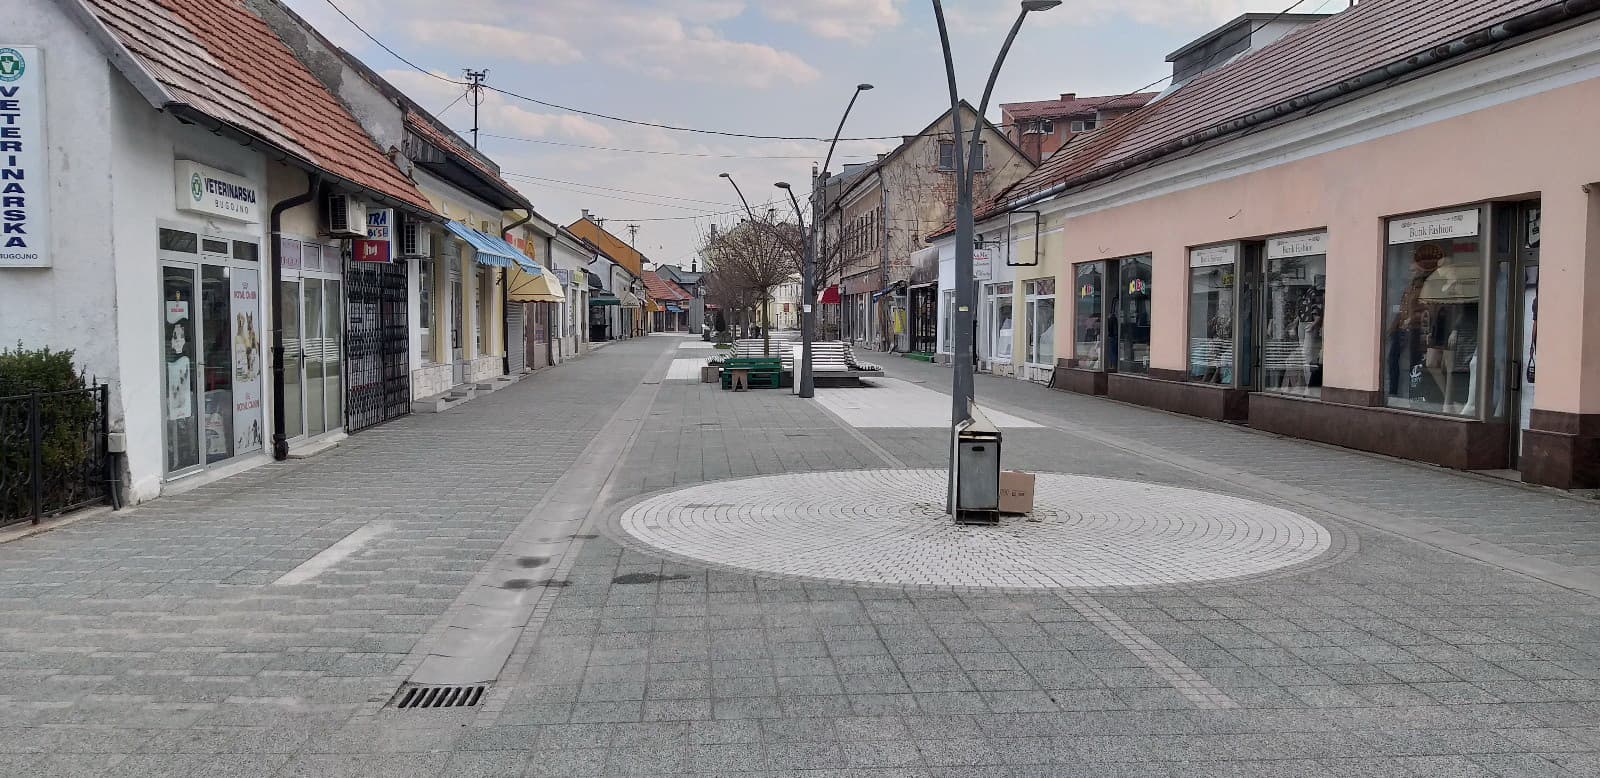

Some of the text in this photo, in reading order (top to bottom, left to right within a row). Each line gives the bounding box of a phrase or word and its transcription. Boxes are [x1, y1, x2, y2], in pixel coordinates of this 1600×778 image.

[0, 86, 27, 248] VETERINARSKA
[204, 177, 256, 204] VETERINARSKA
[215, 200, 249, 214] BUGOJNO
[1428, 224, 1453, 236] Fashion
